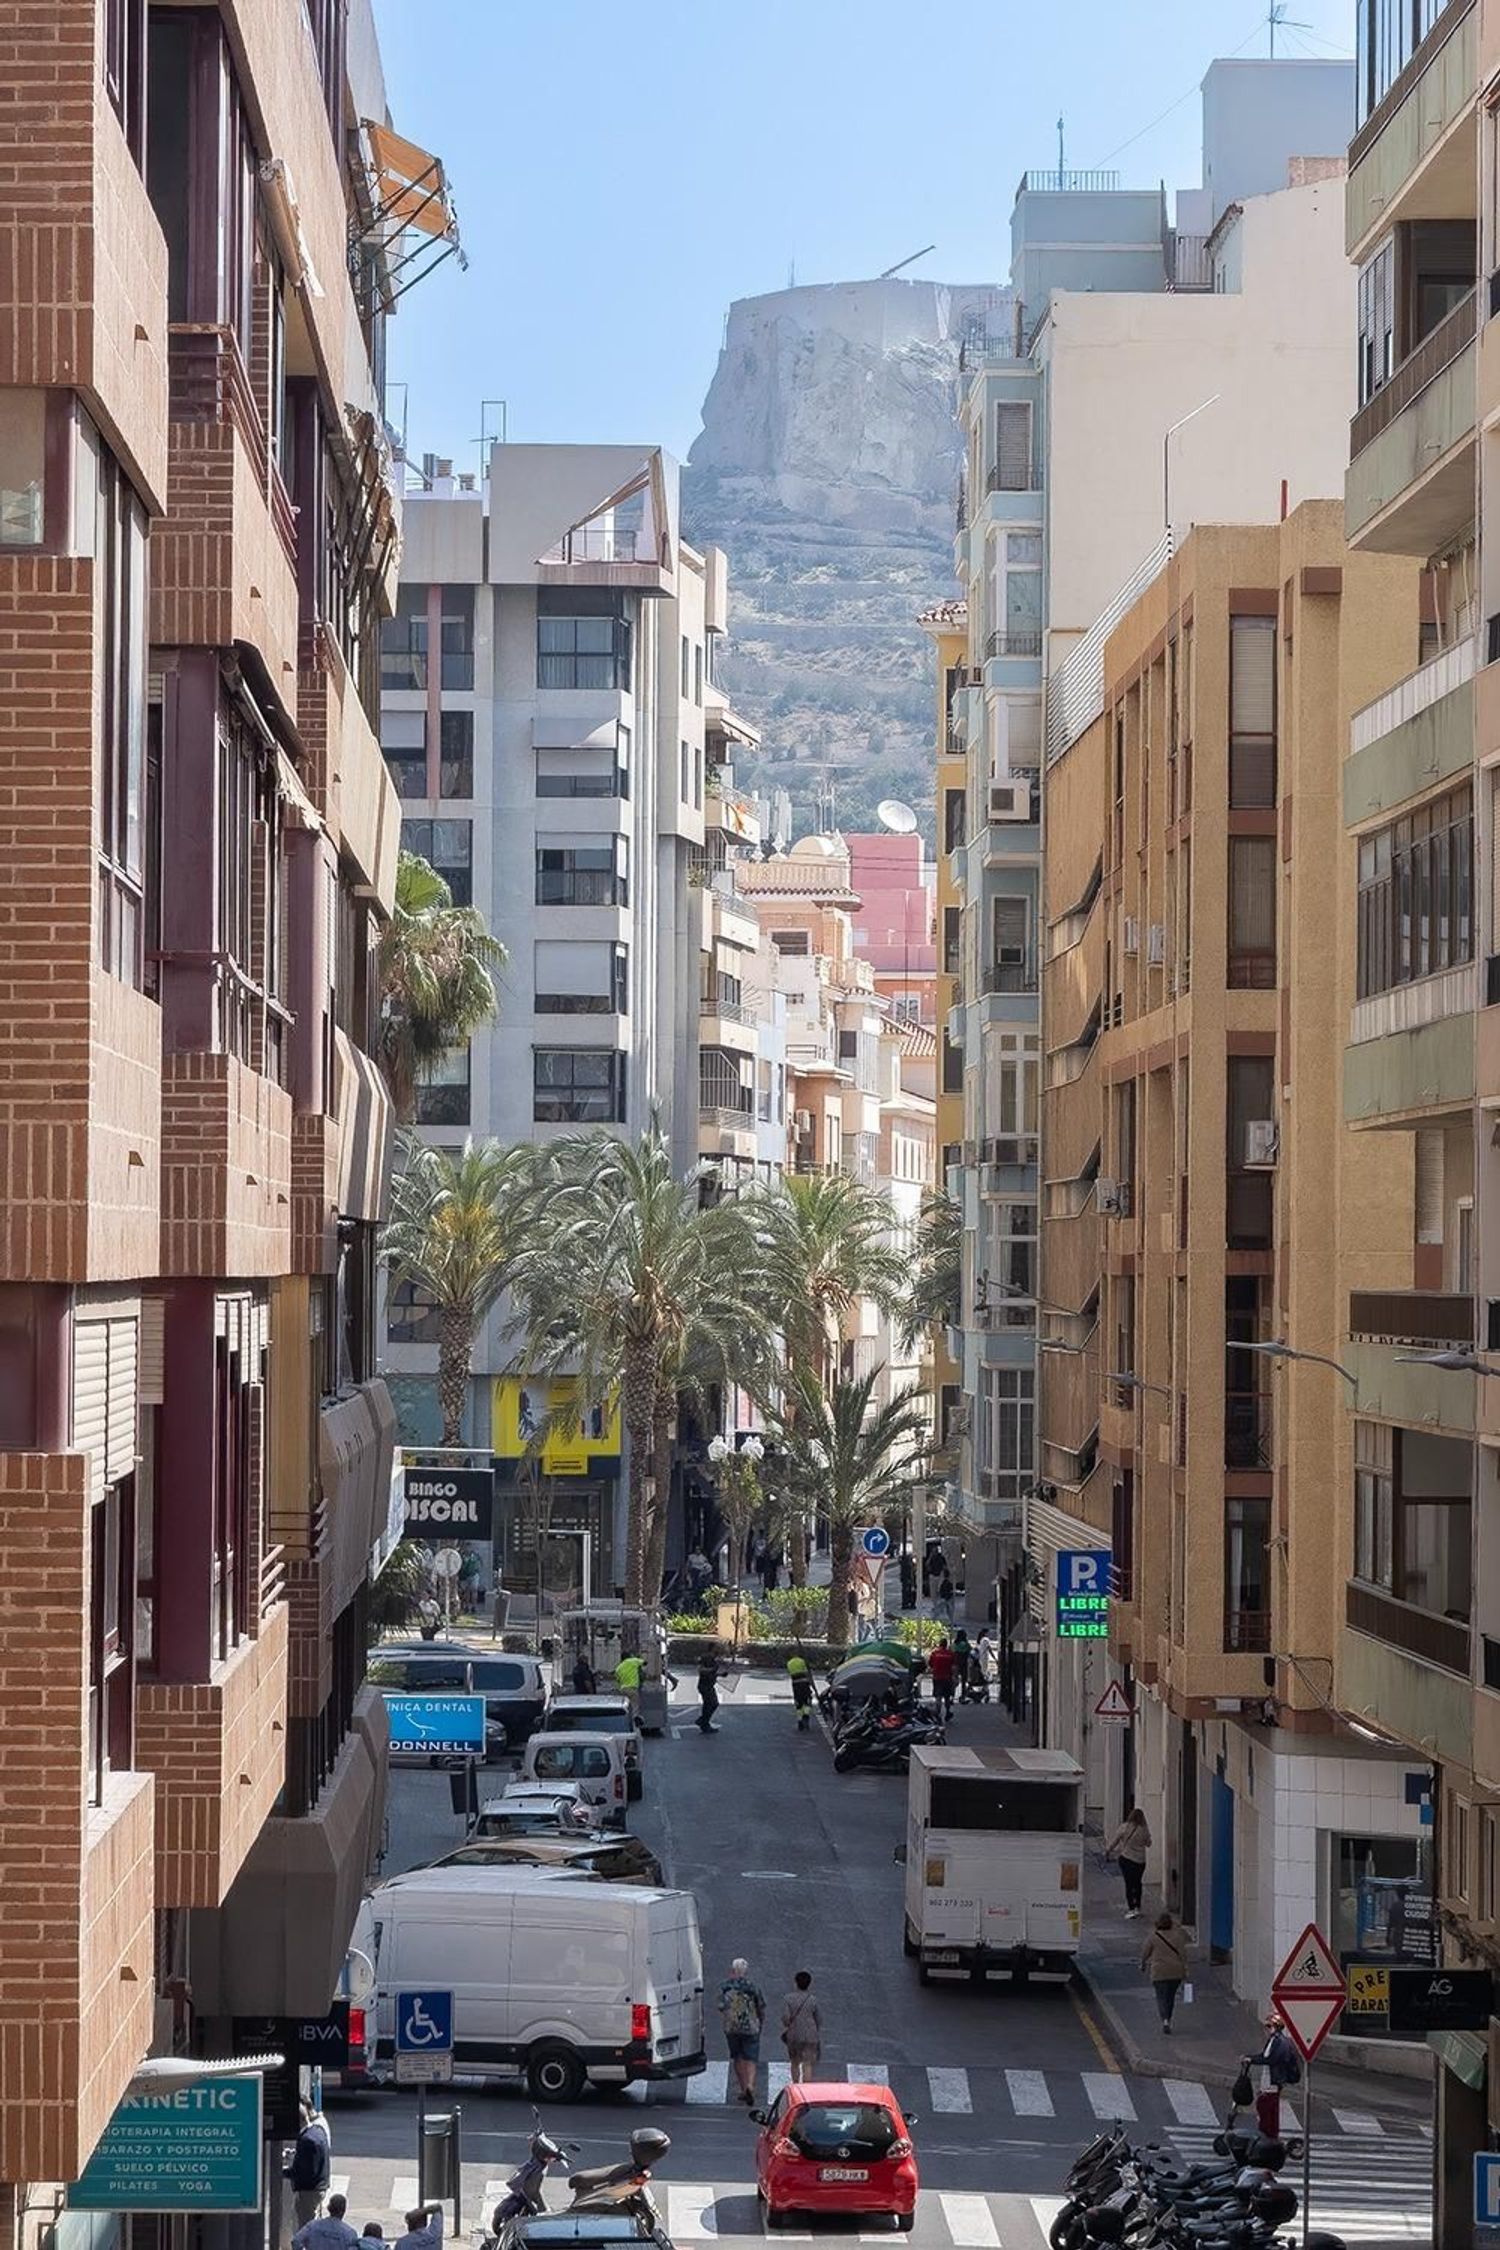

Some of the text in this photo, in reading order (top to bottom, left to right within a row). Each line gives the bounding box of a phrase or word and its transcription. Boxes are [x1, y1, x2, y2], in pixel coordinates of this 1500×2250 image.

[409, 1482, 457, 1496] BINGO
[1071, 1555, 1098, 1589] P
[1060, 1597, 1109, 1610] LIBRE
[1060, 1624, 1109, 1637] LIBRE
[425, 1702, 473, 1712] DENTAL
[1354, 1970, 1386, 1994] PRE
[299, 2024, 342, 2041] BVA
[103, 2127, 235, 2137] IOTERAPIA INTEGRAL
[97, 2145, 239, 2155] BARAZO Y POSTPARTO
[114, 2161, 209, 2173] SUELO PÉLVICO
[109, 2181, 212, 2191] PILATES YOGA
